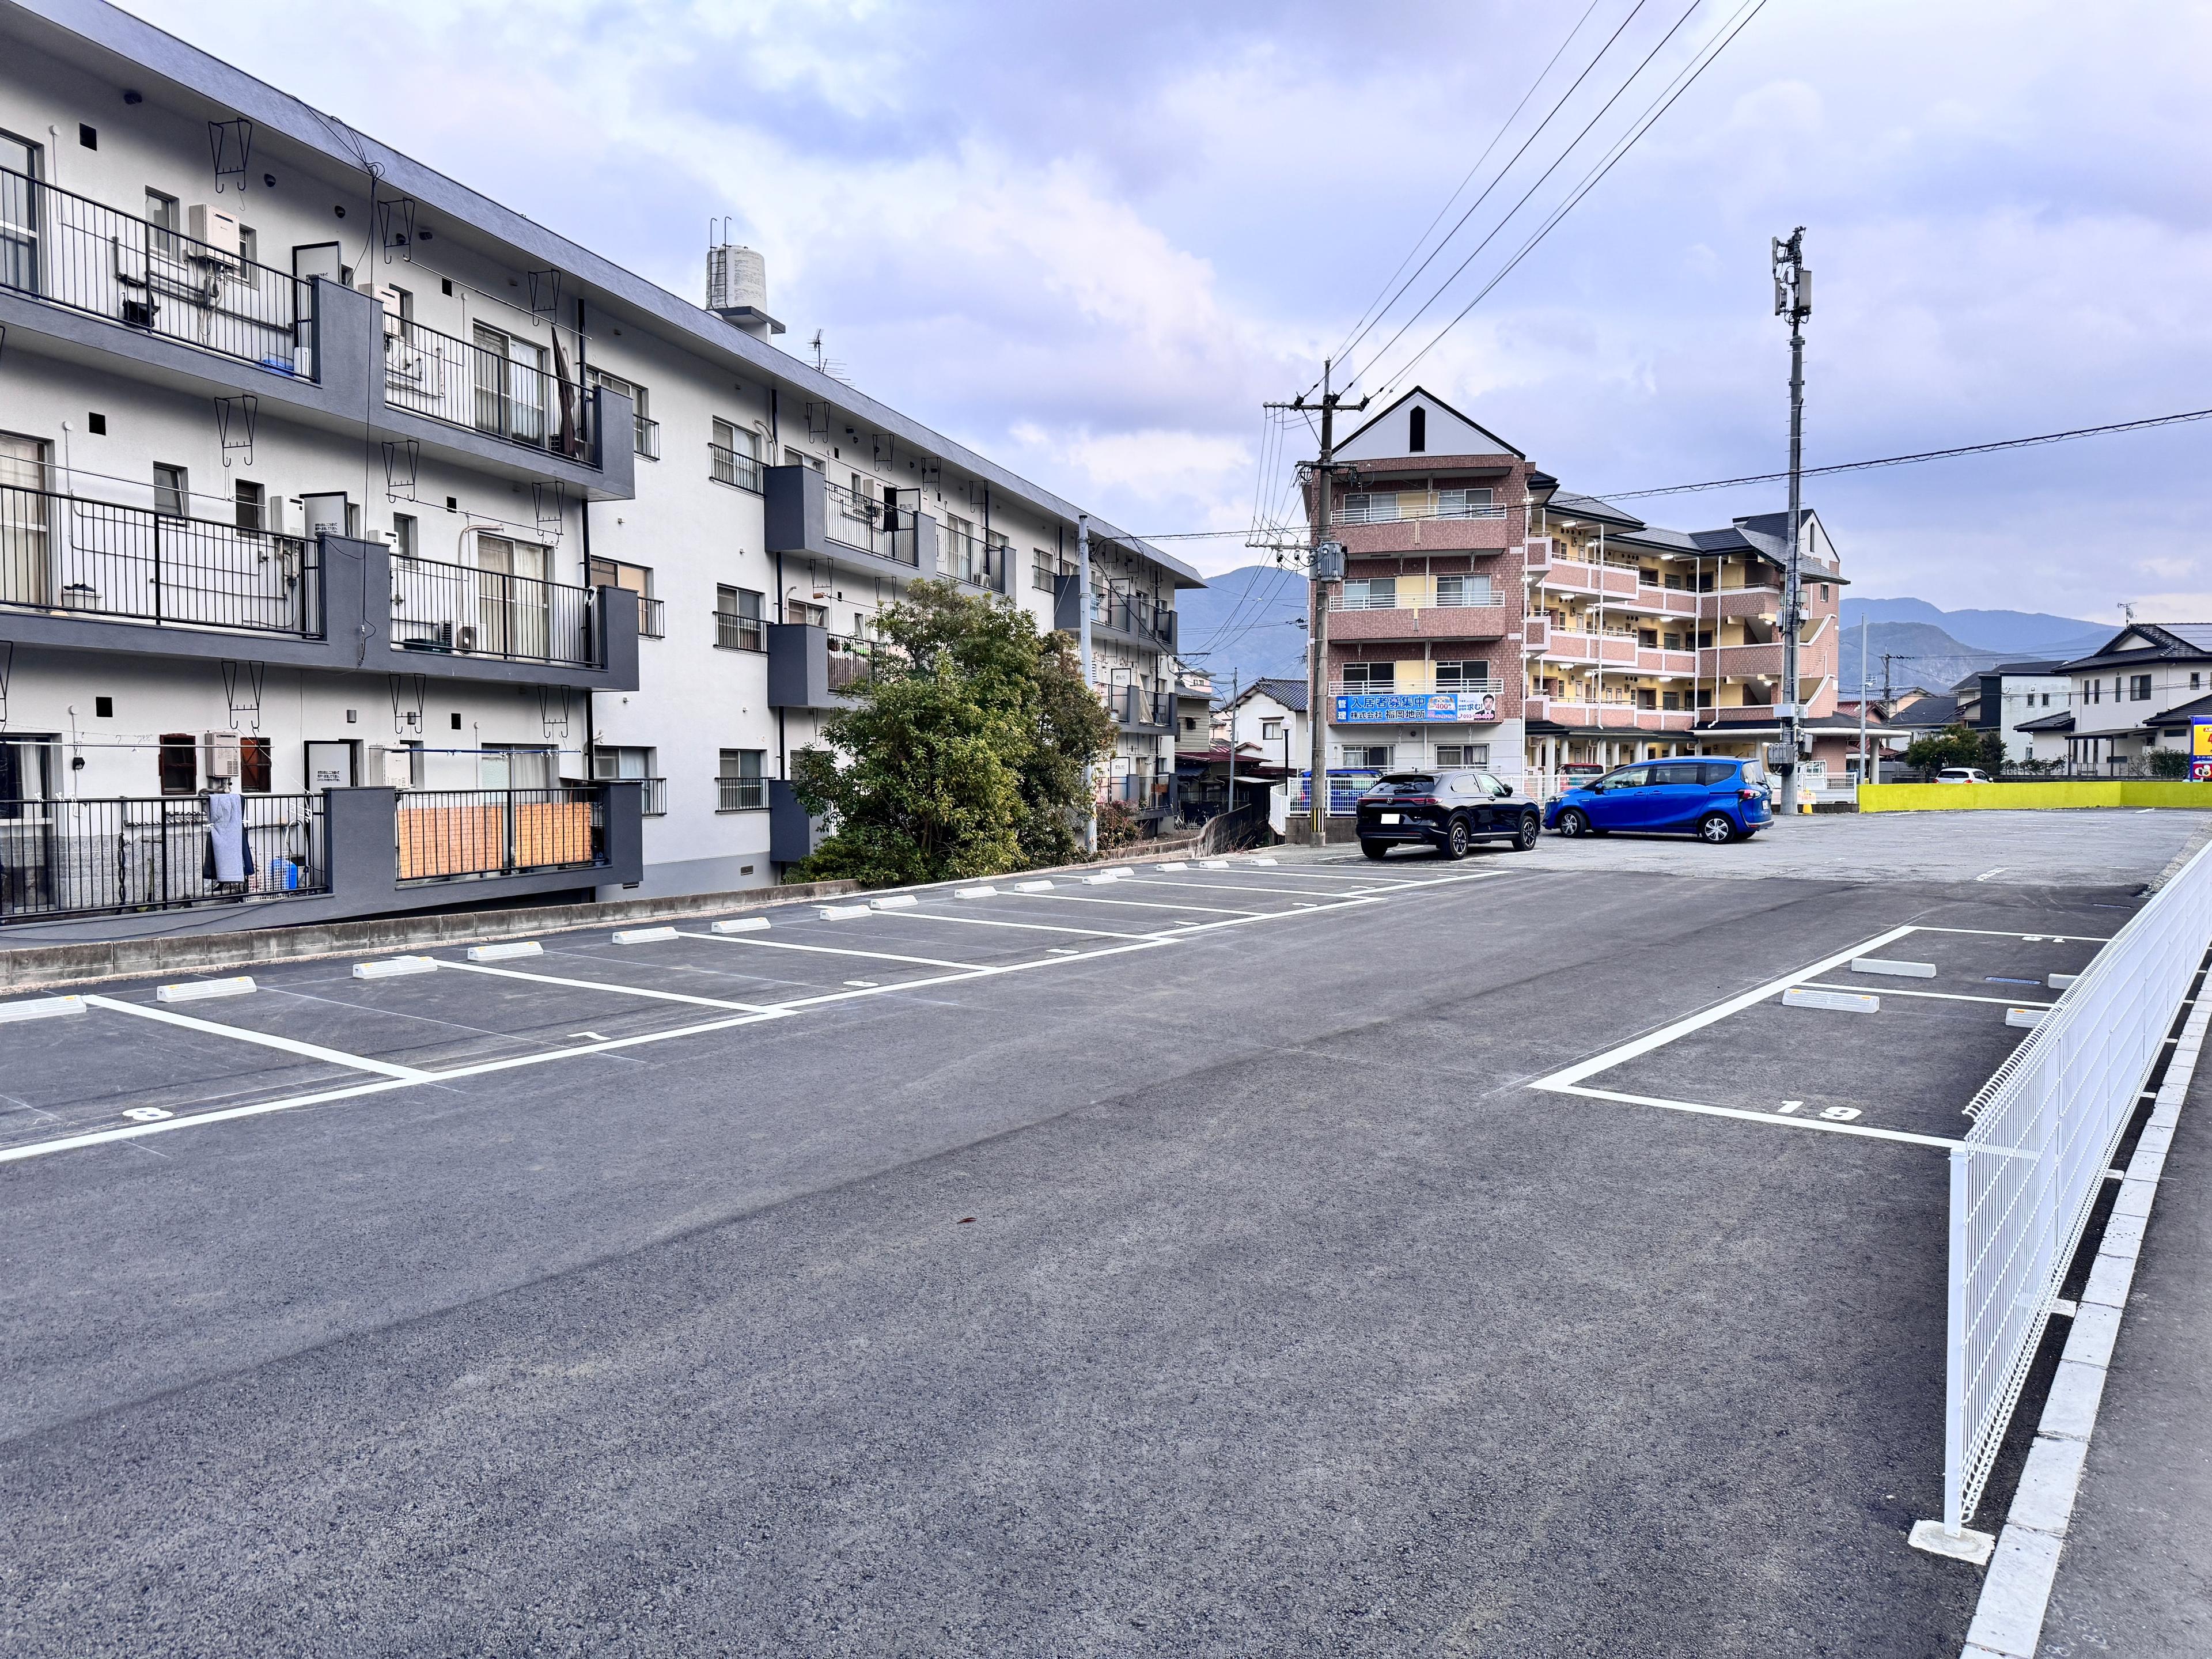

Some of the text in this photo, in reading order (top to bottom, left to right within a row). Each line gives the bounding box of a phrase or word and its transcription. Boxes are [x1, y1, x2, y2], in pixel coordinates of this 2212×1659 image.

[1338, 699, 1347, 719] 管理
[1351, 696, 1425, 709] 入居者募集中
[1350, 711, 1382, 719] 株式会社
[1385, 710, 1425, 719] 福岡地所
[122, 1107, 173, 1120] 8
[1777, 1100, 1862, 1120] 19
